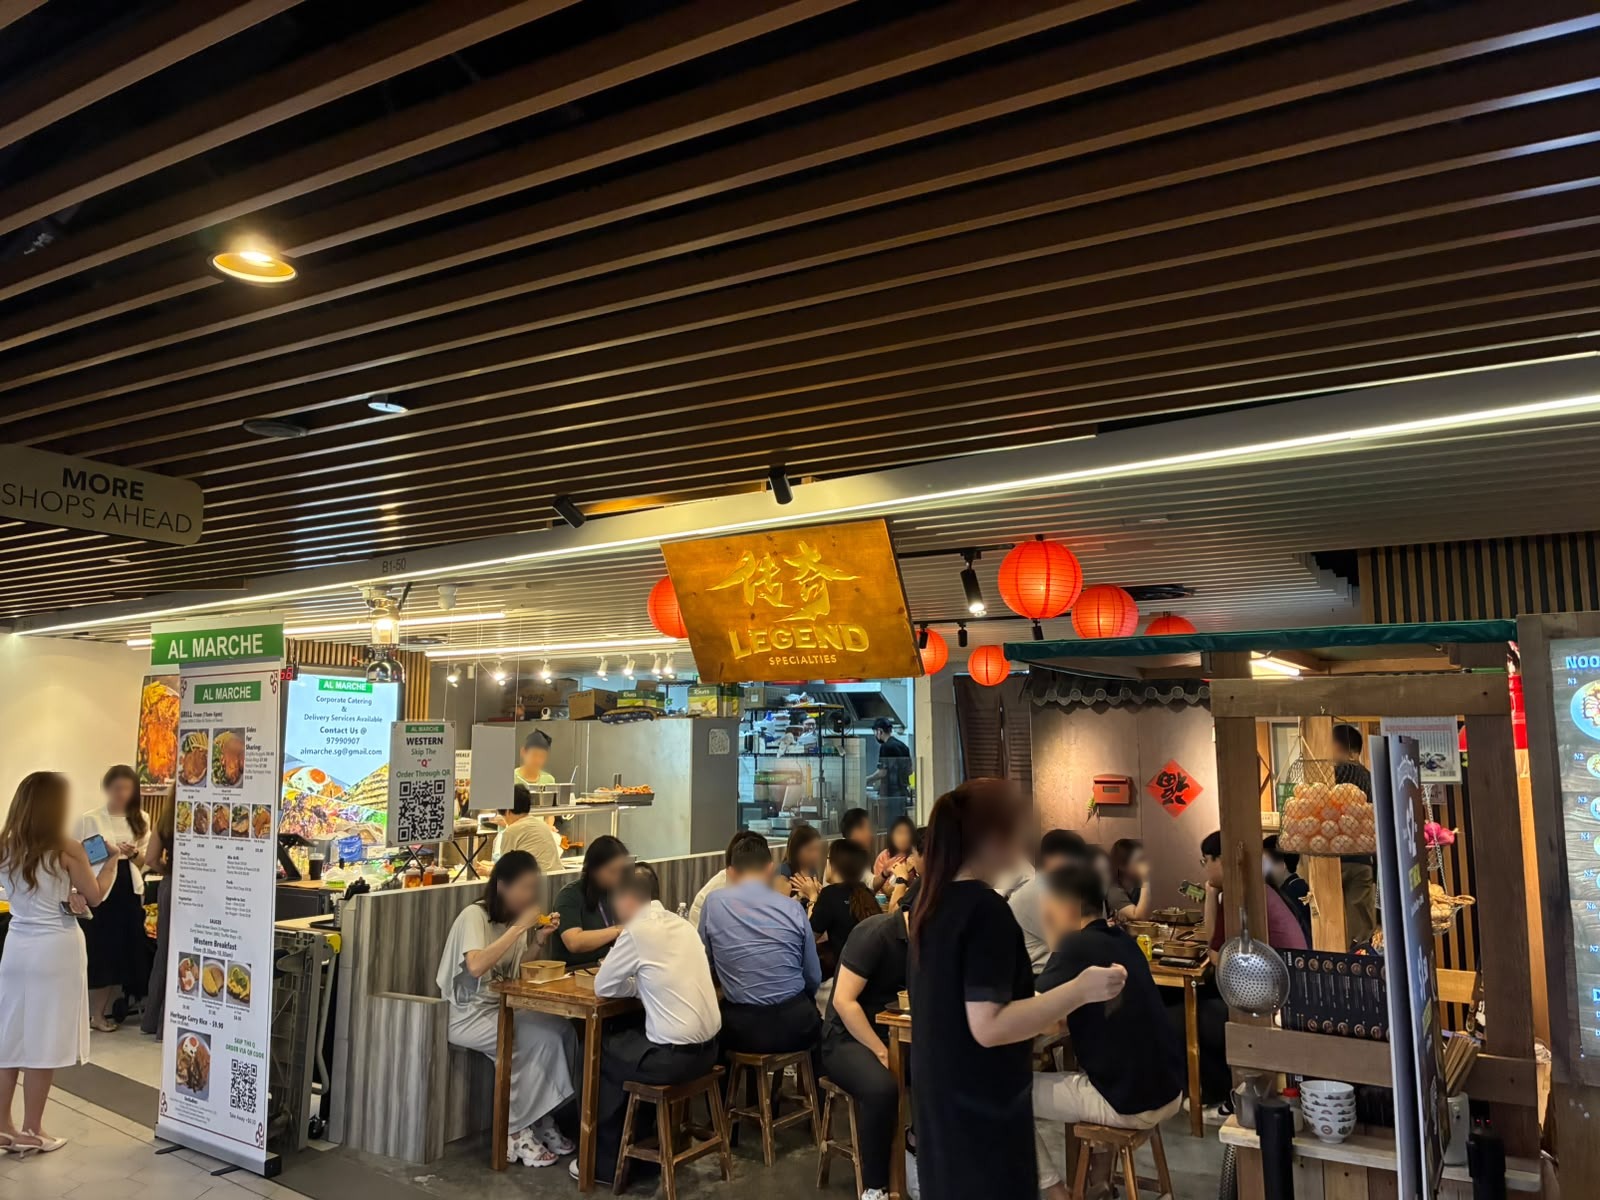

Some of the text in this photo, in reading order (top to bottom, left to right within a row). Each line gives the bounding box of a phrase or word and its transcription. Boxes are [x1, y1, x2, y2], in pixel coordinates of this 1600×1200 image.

[62, 467, 144, 501] MORE
[2, 483, 192, 533] SHOPS AHEAD
[168, 633, 263, 659] AL MARCHE
[728, 624, 870, 660] LEGEND
[768, 654, 837, 666] SPECIALTIES
[335, 680, 366, 691] MARCHE
[1567, 677, 1577, 685] N1
[203, 686, 251, 701] AL MARCHE
[316, 696, 373, 706] Corporate Catering
[304, 713, 330, 722] Delivery
[320, 726, 368, 736] Contact Us @
[326, 736, 360, 745] 97990907
[406, 737, 444, 746] WESTERN
[300, 747, 383, 757] almarche.sg@gmail.com
[411, 748, 424, 757] Skip
[396, 768, 451, 778] Order Through QR
[1156, 770, 1190, 806] 福
[193, 936, 237, 951] Western Breakfast
[170, 1011, 187, 1021] Heritage
[187, 1014, 199, 1024] Curry
[199, 1017, 208, 1026] Rice
